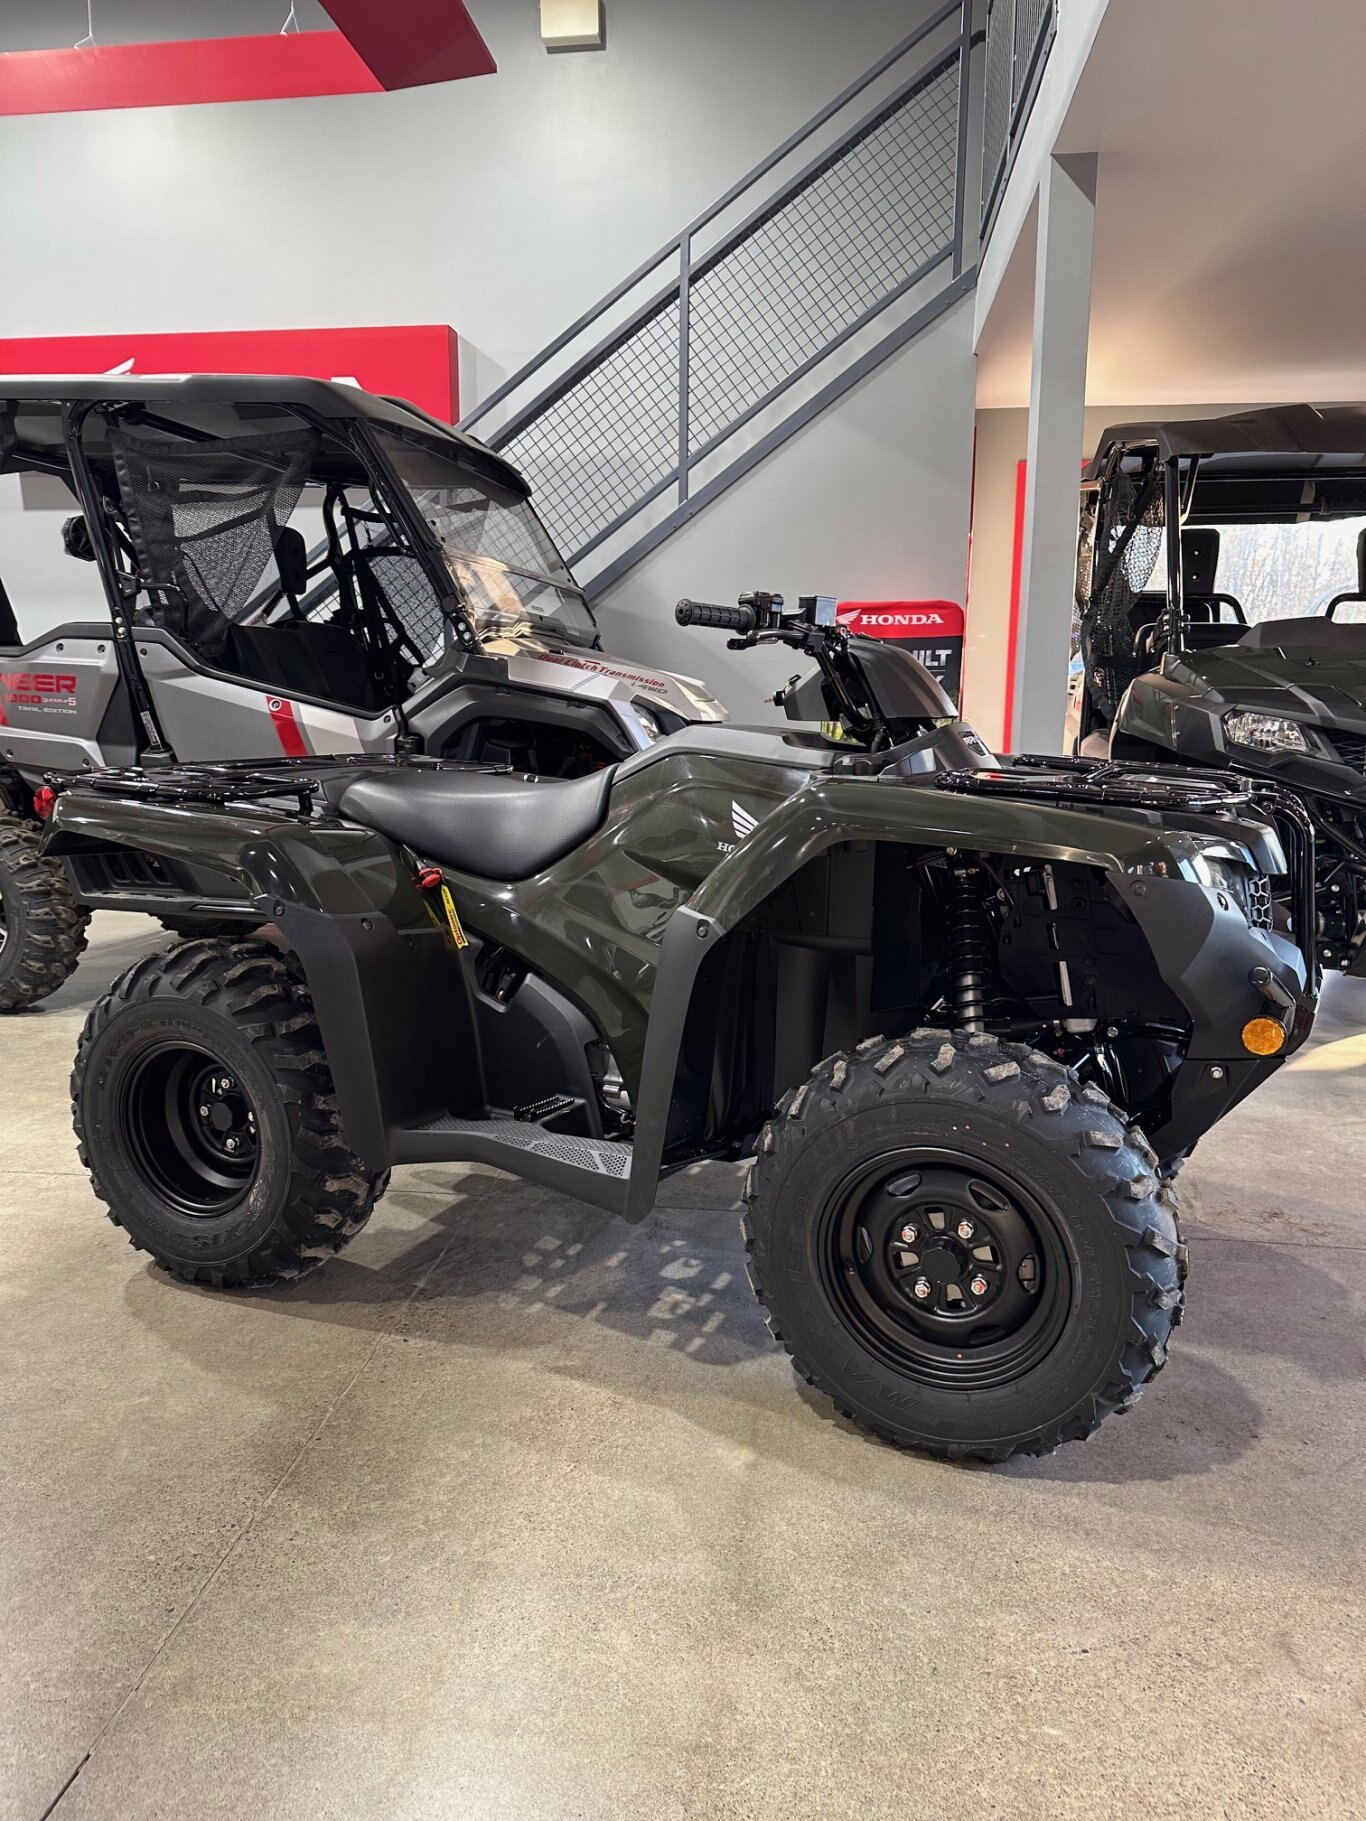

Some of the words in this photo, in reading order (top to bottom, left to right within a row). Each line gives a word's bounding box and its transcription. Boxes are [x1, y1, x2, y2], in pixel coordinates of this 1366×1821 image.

[860, 614, 944, 625] HONDA
[599, 666, 665, 687] Transmission
[43, 707, 77, 715] EDITION
